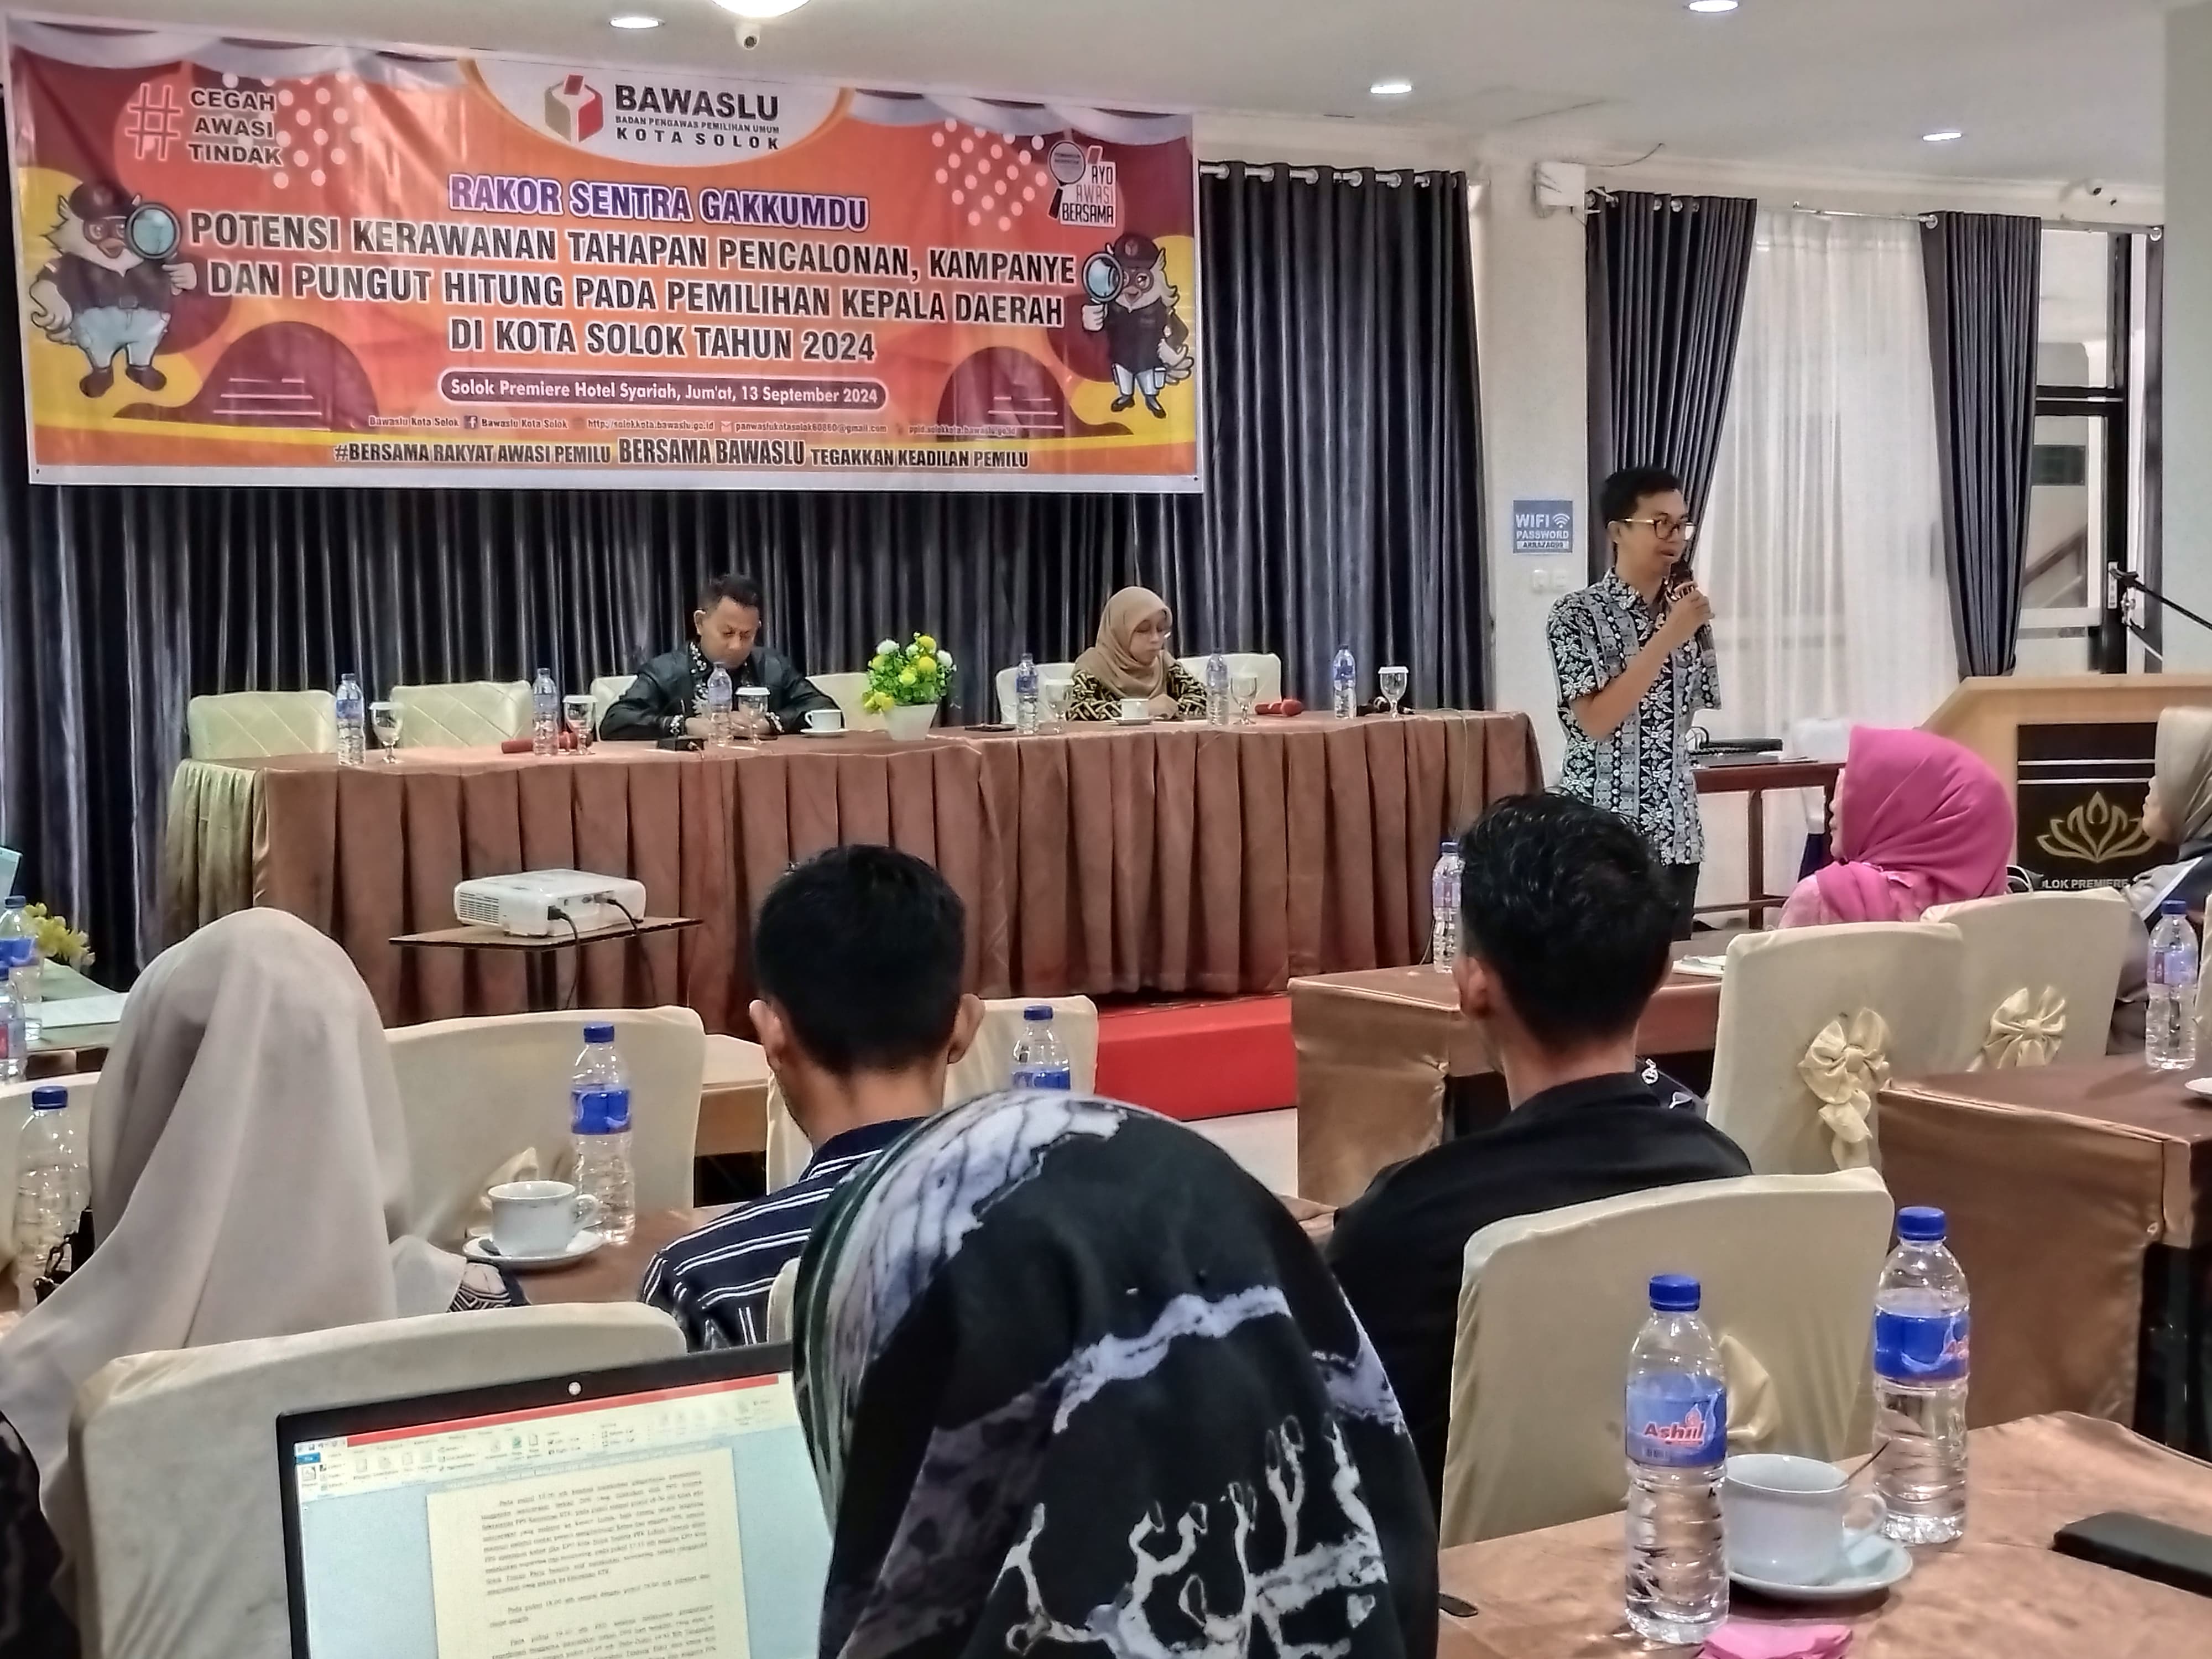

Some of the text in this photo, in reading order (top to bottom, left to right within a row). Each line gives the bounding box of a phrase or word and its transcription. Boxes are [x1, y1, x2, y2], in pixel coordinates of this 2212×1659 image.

[191, 89, 275, 111] CEGAH
[615, 85, 779, 121] BAWASLU
[194, 117, 274, 139] AWASI
[615, 115, 779, 134] BADAN PENGAWAS PEMILIHAN UMUM
[616, 127, 779, 150] KOTA SOLOK
[189, 143, 283, 166] TINDAK
[1092, 165, 1113, 185] AYO
[450, 174, 869, 233] RAKOR SENTRA GAKKUMDU
[1076, 184, 1113, 204] AWASI
[1062, 202, 1114, 224] BERSAMA
[192, 212, 1076, 285] POTENSI KERAWANAN TAHAPAN PENCALONAN, KAMPANYE
[210, 262, 1064, 327] DAN PUNGUT HITUNG PADA PEMILIHAN KEPALA DAERAH
[451, 317, 875, 362] DI KOTA SOLOK TAHUN 2024
[451, 378, 879, 406] Solok Premiere Hotel Syariah, Jum'at, 13 September 2024
[369, 416, 460, 427] Bawaslu Kota Solok
[481, 418, 519, 428] Bawaslu
[521, 419, 541, 429] Kota
[544, 419, 568, 429] Solok
[335, 437, 1029, 468] #BERSAMA RAKYAT AWASI PEMILU BERSAMA BAWASLU TEGAKKAN KEADILAN PEMILU
[1515, 513, 1550, 528] WIFI
[1516, 530, 1569, 540] PASSWORD
[2042, 879, 2069, 889] LOK
